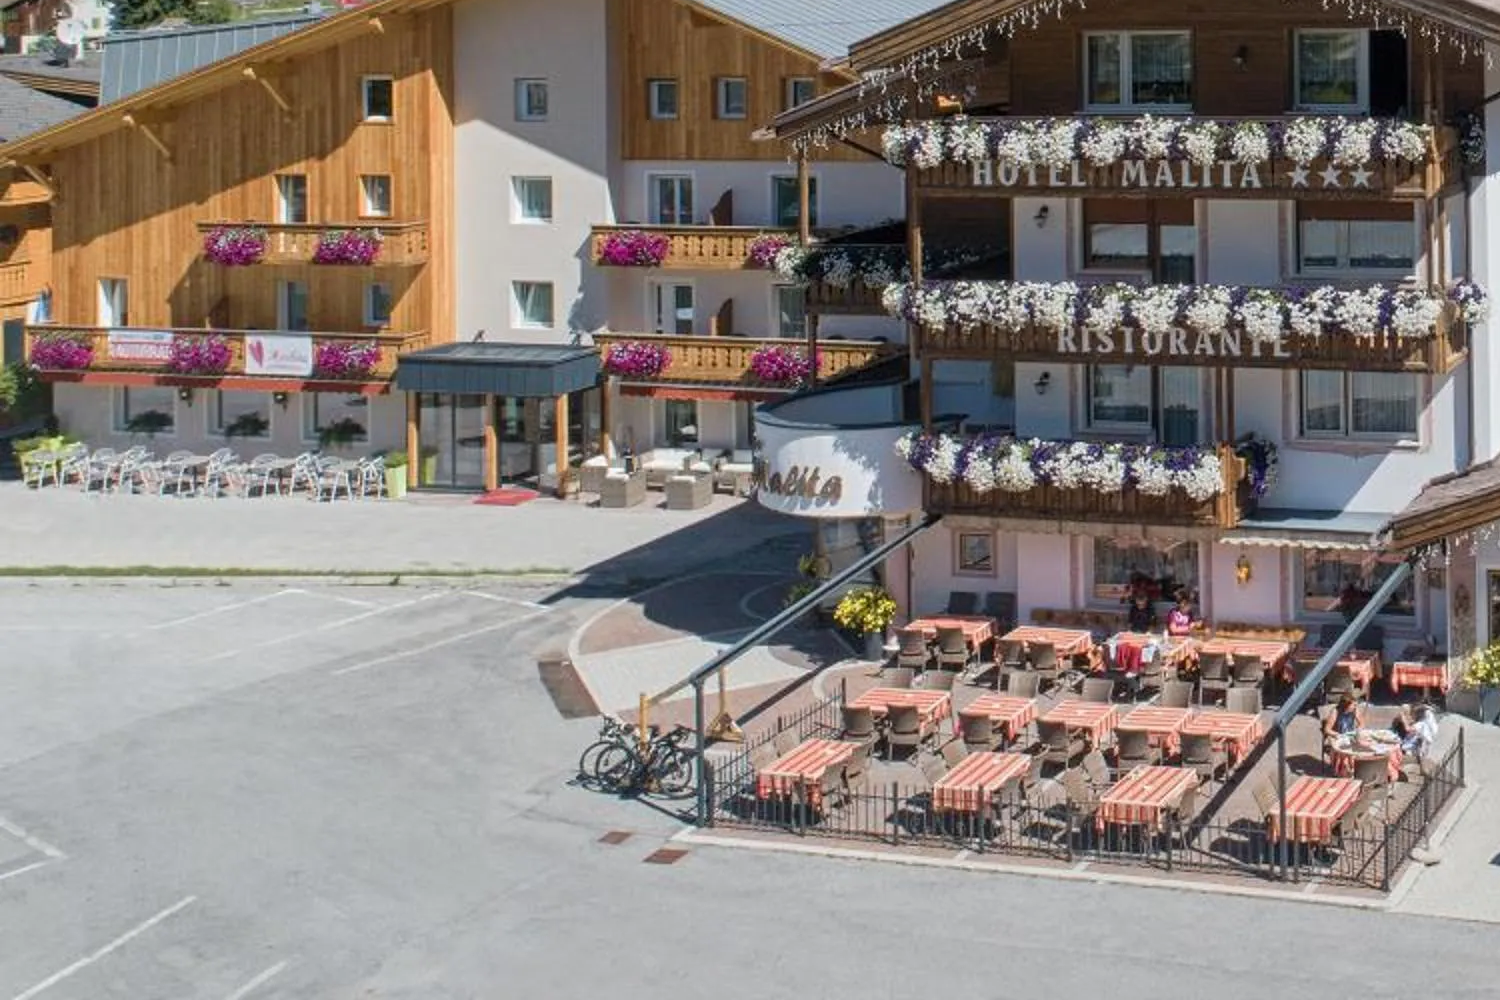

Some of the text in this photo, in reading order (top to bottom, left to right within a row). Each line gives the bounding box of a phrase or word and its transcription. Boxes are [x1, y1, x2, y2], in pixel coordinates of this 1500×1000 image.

[973, 159, 1262, 188] HOTEL MALITA
[1057, 326, 1292, 357] RISTORANTE
